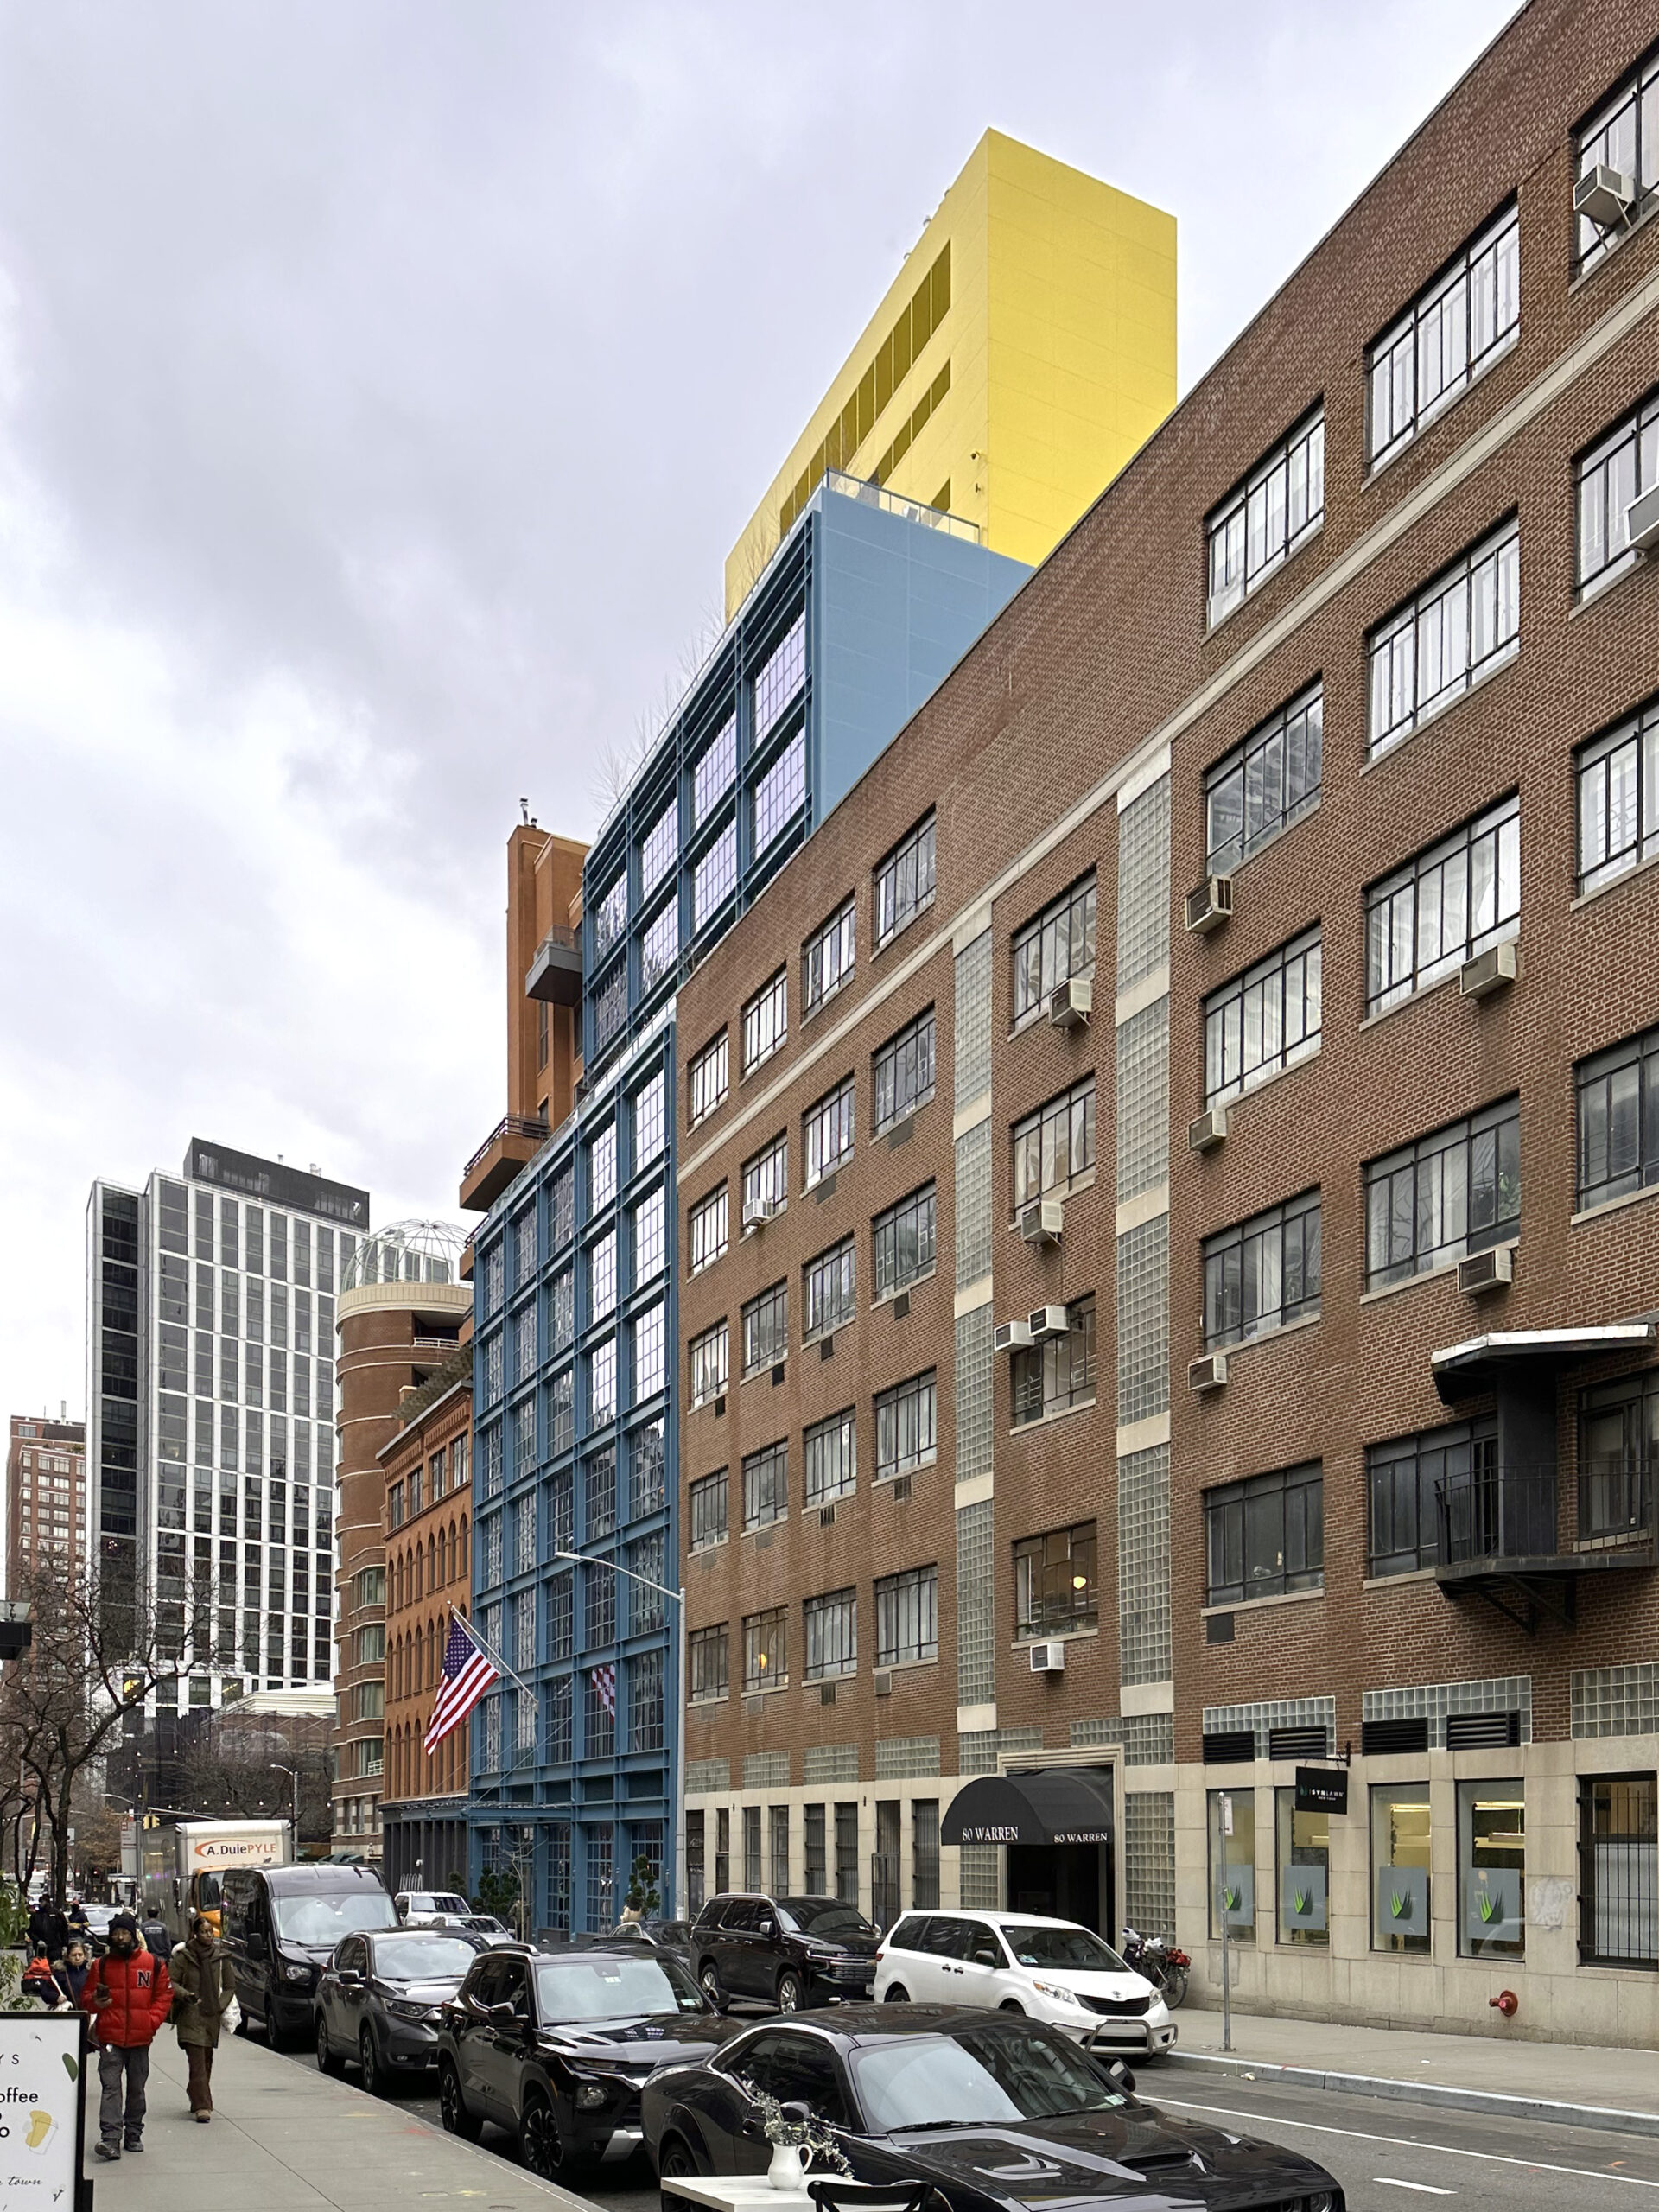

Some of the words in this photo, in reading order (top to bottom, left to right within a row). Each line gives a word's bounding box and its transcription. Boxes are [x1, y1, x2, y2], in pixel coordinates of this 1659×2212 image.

[962, 1827, 973, 1841] 80
[975, 1826, 1019, 1841] WARREN
[1053, 1834, 1065, 1843] 80
[1066, 1832, 1108, 1843] WARREN
[137, 1970, 152, 1987] N
[8, 2176, 42, 2186] town
